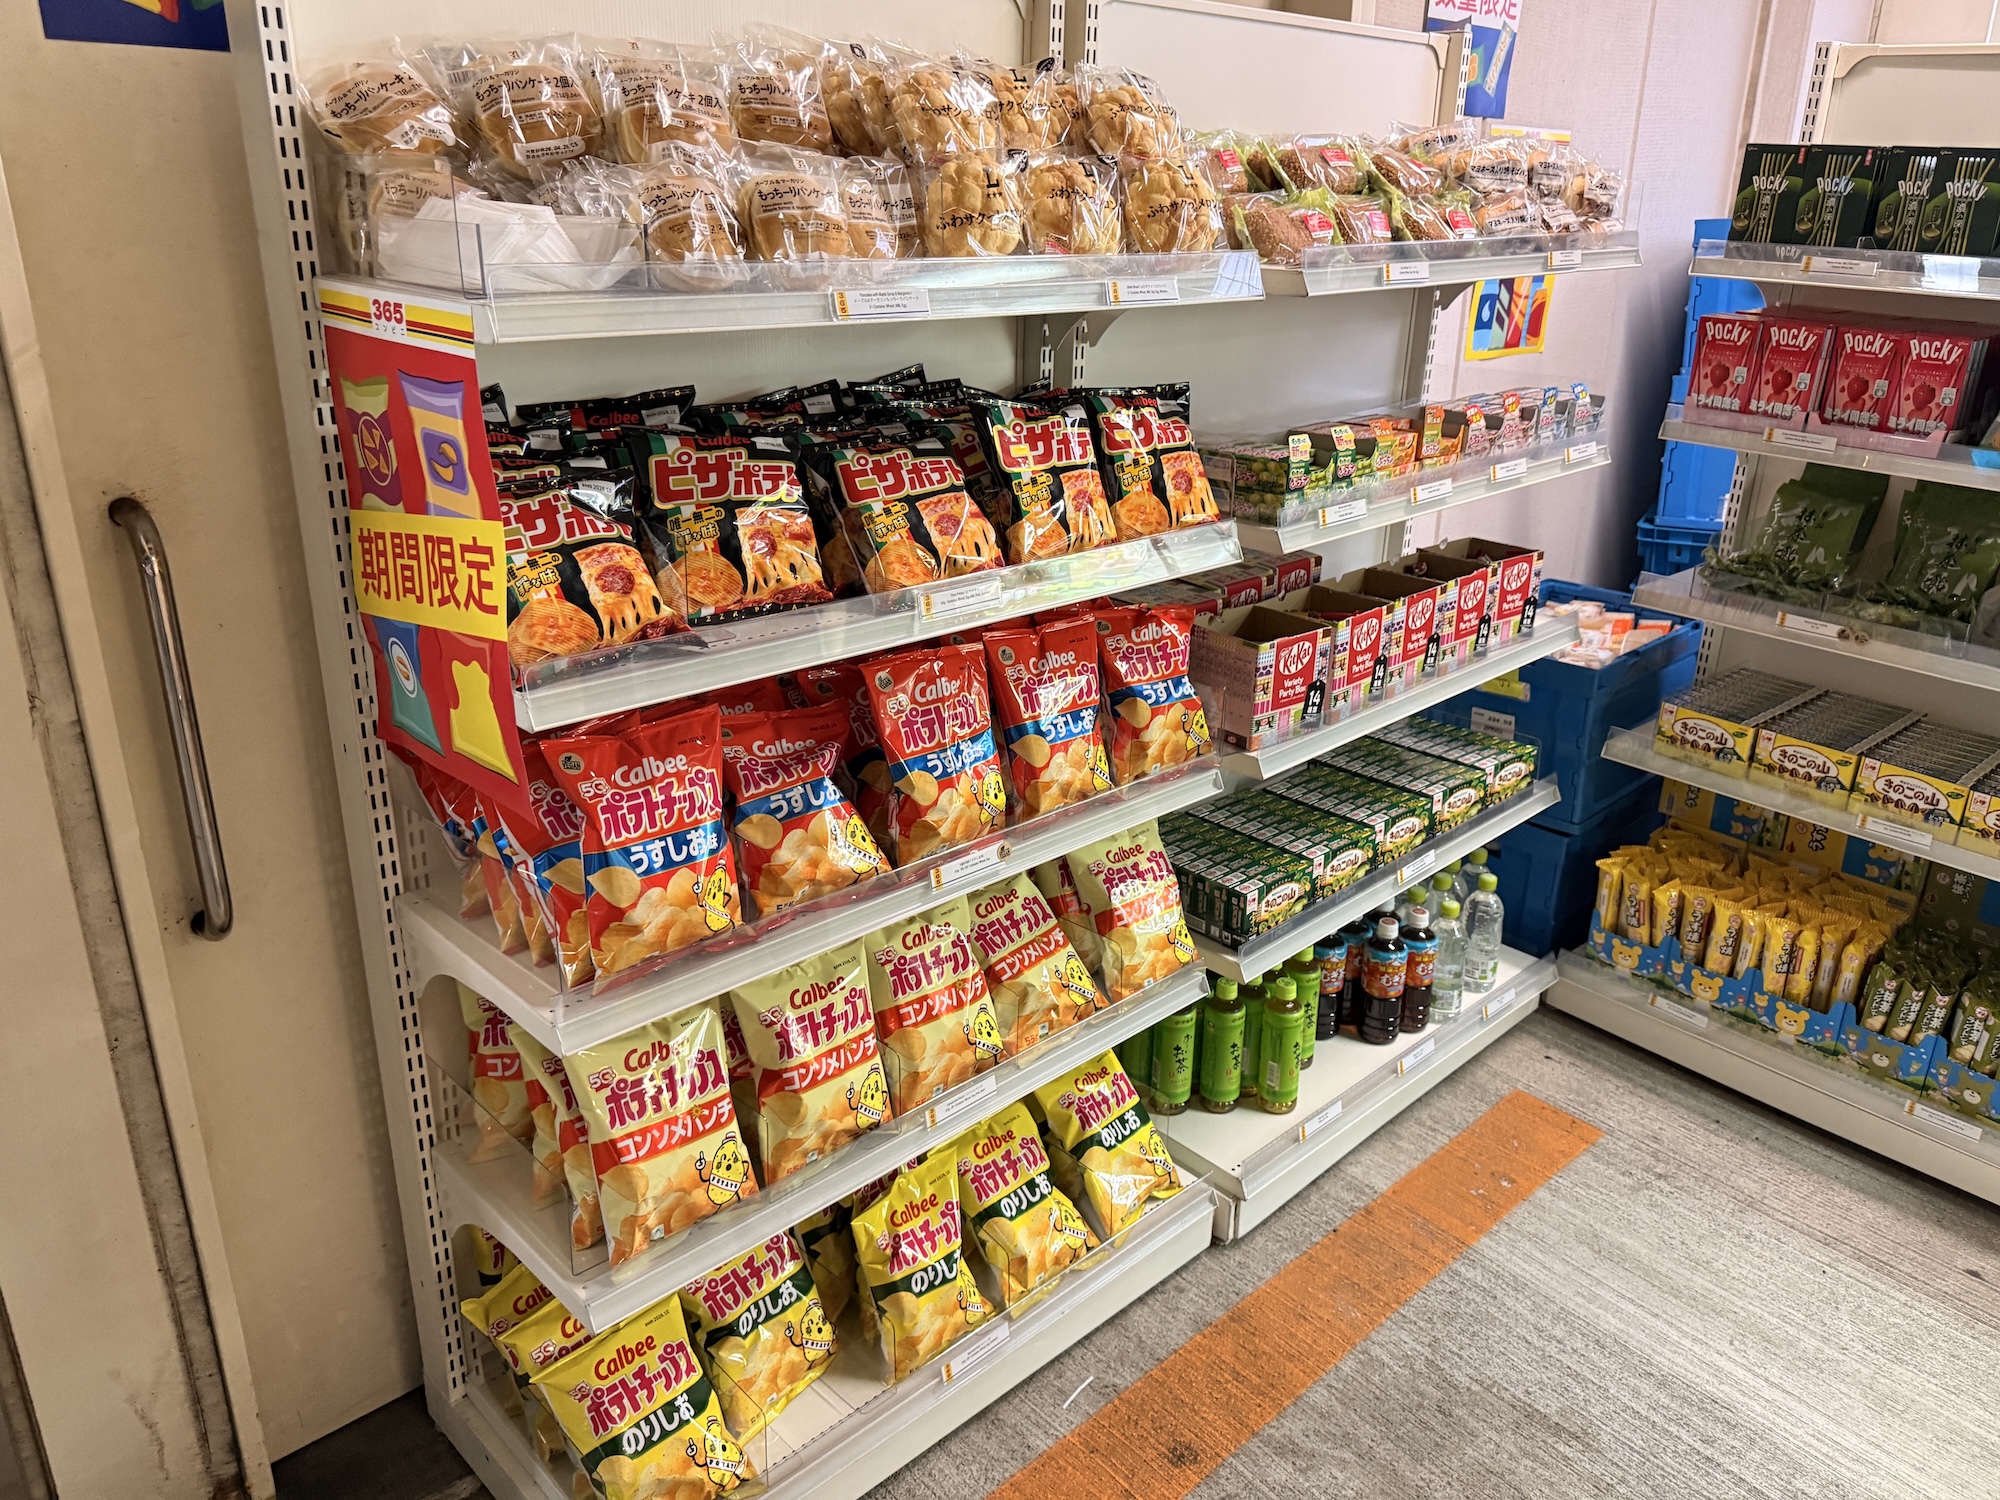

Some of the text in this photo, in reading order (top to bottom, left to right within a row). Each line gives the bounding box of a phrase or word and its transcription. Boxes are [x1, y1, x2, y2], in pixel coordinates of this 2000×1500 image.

[372, 299, 404, 324] 365
[839, 292, 847, 314] 365
[375, 323, 405, 336] コンビニ
[589, 413, 639, 426] Calbee
[652, 448, 803, 504] ピザポテト
[839, 449, 962, 505] ピザポテト
[668, 507, 724, 532] 唯一無二の
[863, 504, 910, 529] 唯一無二の
[874, 516, 909, 539] 罪な味
[677, 523, 720, 545] 罪な味
[358, 527, 498, 616] 期間限定
[515, 569, 557, 597] 罪な味
[1502, 601, 1514, 611] Party
[1506, 593, 1522, 602] Variety
[1463, 611, 1478, 621] Variety
[1524, 604, 1534, 619] 14
[1131, 623, 1179, 643] Calbee
[1411, 631, 1426, 642] Variety
[1460, 620, 1471, 631] Party
[1479, 621, 1488, 637] 14
[1356, 652, 1372, 663] Variety
[1407, 642, 1419, 652] Party
[1428, 642, 1437, 658] 14
[1029, 651, 1076, 674] Calbee
[1352, 665, 1365, 675] Party
[1375, 664, 1384, 680] 14
[1279, 688, 1295, 699] Party
[1284, 677, 1304, 688] Variety
[1309, 690, 1320, 706] 14
[1679, 720, 1728, 746] きのこの山
[752, 738, 816, 757] Calbee
[614, 754, 688, 788] Calbee
[1778, 748, 1830, 775] きのこの山
[1447, 793, 1473, 813] きのこの山
[1882, 778, 1940, 807] きのこの山
[600, 768, 722, 843] ポテトチップス
[1389, 820, 1417, 844] きのこの山
[630, 829, 718, 875] うすしお味
[1106, 843, 1144, 864] Calbee
[1329, 853, 1361, 877] きのこの山
[975, 888, 1018, 920] Calbee
[1264, 887, 1297, 912] きのこの山
[901, 921, 954, 951] Calbee
[974, 894, 1054, 959] ポテトチップス
[994, 927, 1065, 982] コンソメパンチ
[790, 975, 845, 1010] Calbee
[899, 975, 984, 1028] コンソメパンチ
[1070, 983, 1095, 998] POTATO
[783, 1034, 878, 1091] コンソメパンチ
[1173, 1044, 1189, 1074] お茶
[1074, 1066, 1110, 1093] Calbee
[858, 1103, 882, 1120] POTATO
[1074, 1071, 1136, 1131] ポテトチップス
[616, 1097, 733, 1163] コンソメパンチ
[1101, 1110, 1141, 1148] のりしお
[973, 1129, 1017, 1161] Calbee
[710, 1175, 740, 1191] POTATO
[970, 1137, 1047, 1204] ポテトチップス
[1001, 1174, 1052, 1218] のりしお
[889, 1191, 939, 1228] Calbee
[702, 1232, 800, 1322] ポテトチップス
[739, 1280, 798, 1337] のりしお
[594, 1333, 657, 1381] Calbee
[805, 1340, 831, 1350] POTATO
[585, 1340, 698, 1440] ポテトチップス
[622, 1394, 695, 1455] のりしお
